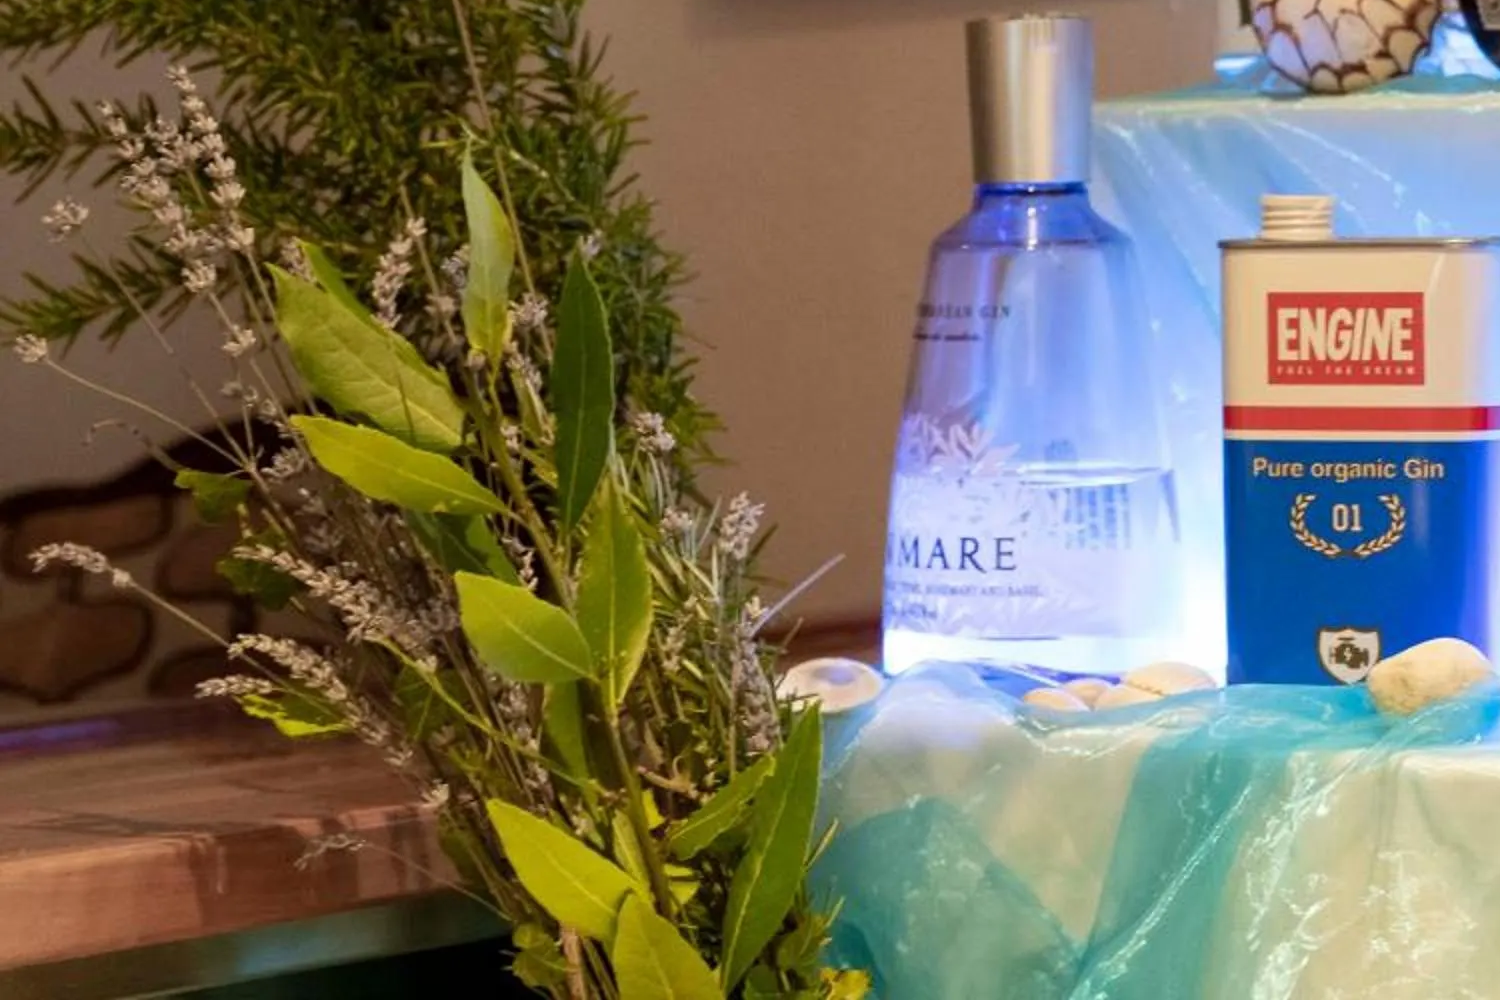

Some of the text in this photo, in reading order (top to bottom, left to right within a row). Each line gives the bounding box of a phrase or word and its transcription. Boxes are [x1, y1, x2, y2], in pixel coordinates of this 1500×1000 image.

[1277, 307, 1415, 361] ENGINE
[1253, 457, 1445, 483] Pure organic Gin
[1332, 503, 1364, 532] 01
[898, 535, 1018, 574] MARE
